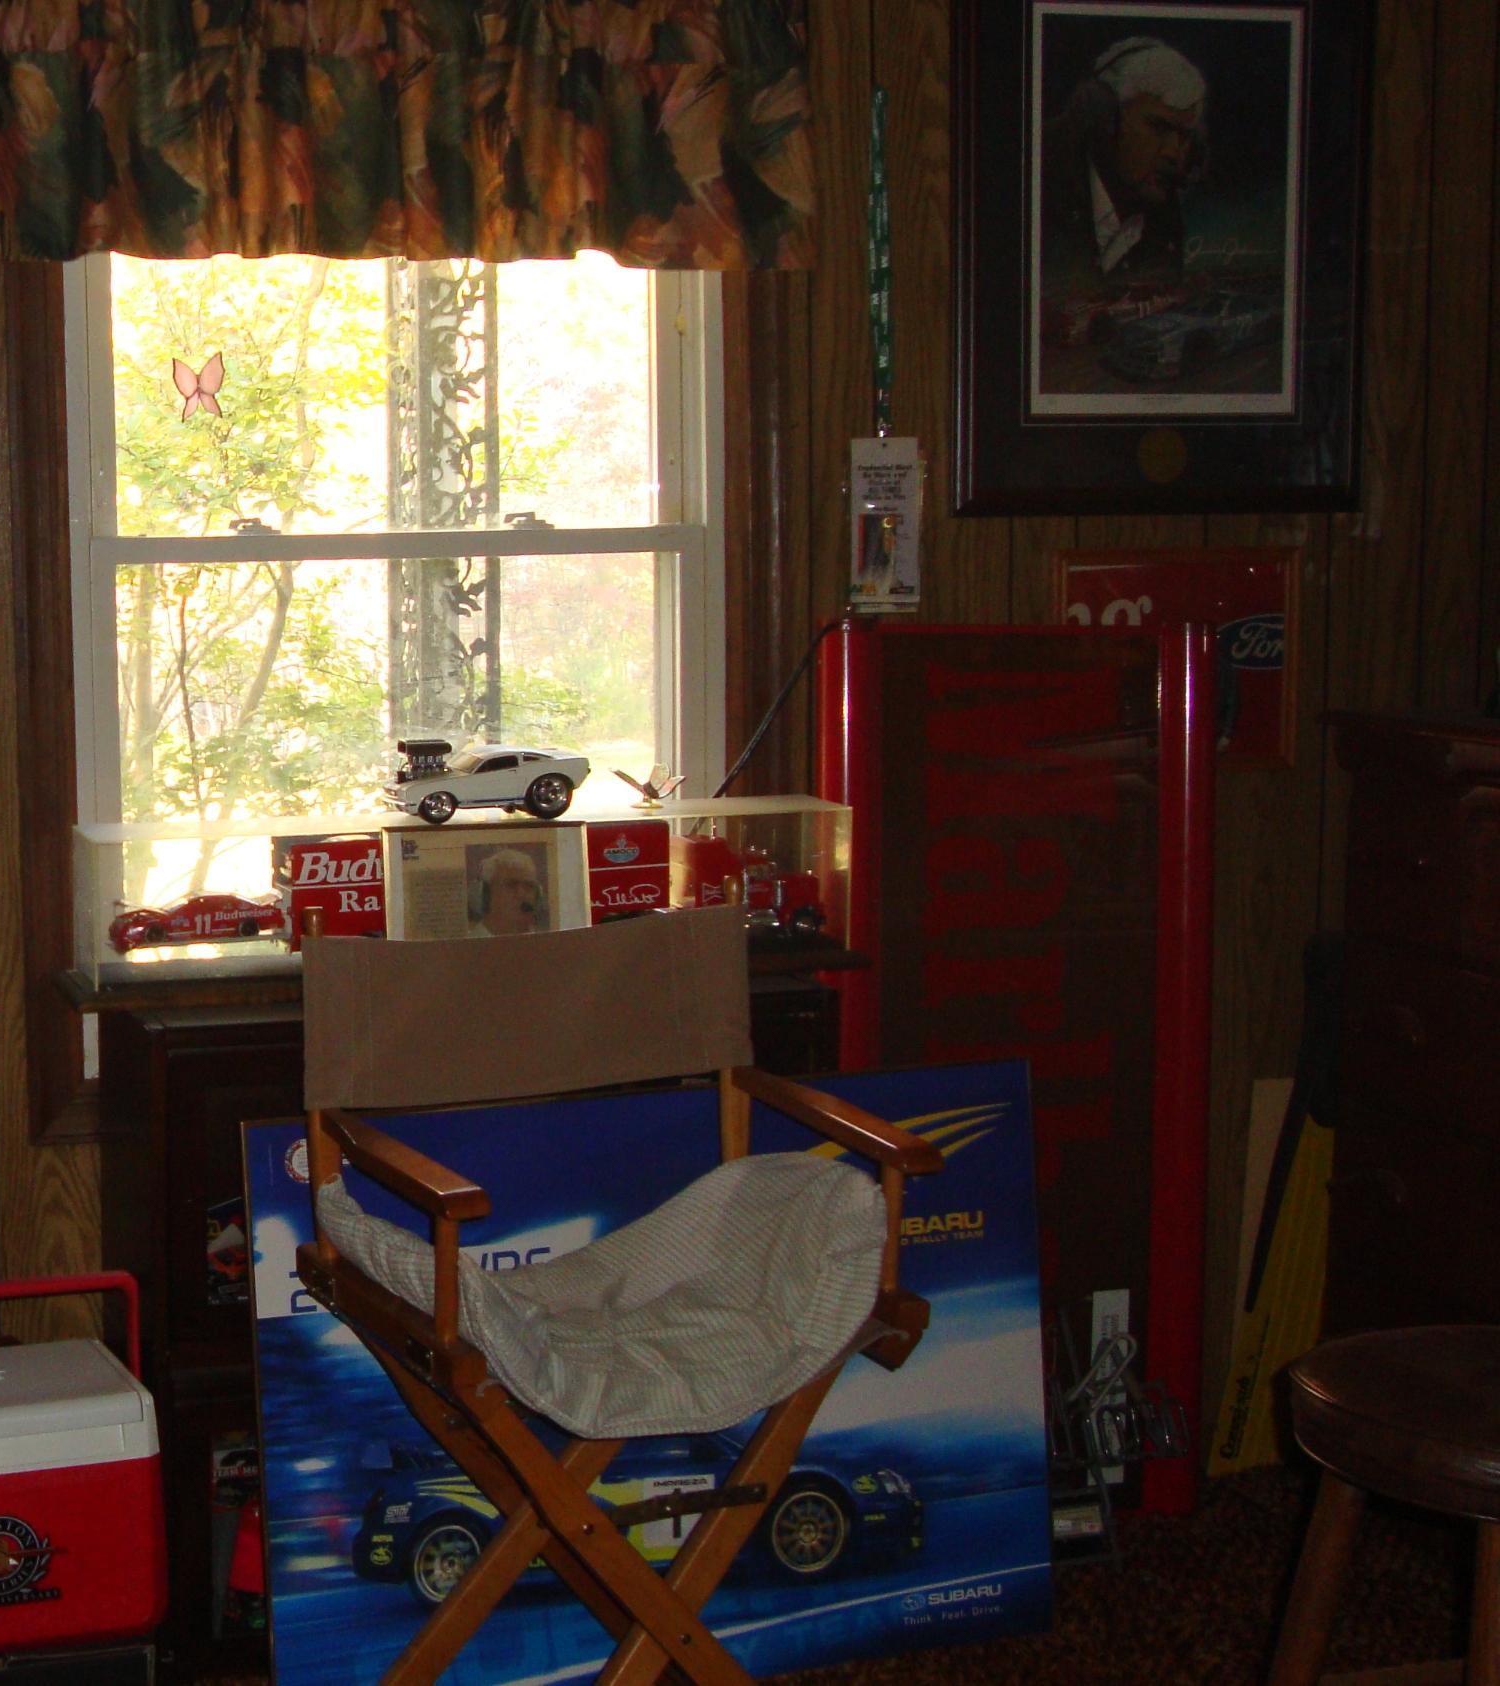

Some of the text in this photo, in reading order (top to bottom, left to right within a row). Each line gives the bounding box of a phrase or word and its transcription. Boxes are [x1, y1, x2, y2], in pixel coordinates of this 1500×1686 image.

[1231, 622, 1285, 659] For
[194, 914, 212, 934] 11
[214, 909, 275, 921] Budweiser
[900, 1209, 985, 1237] BARU
[652, 1477, 708, 1488] IMPREZA
[928, 1583, 1002, 1605] SUBARU
